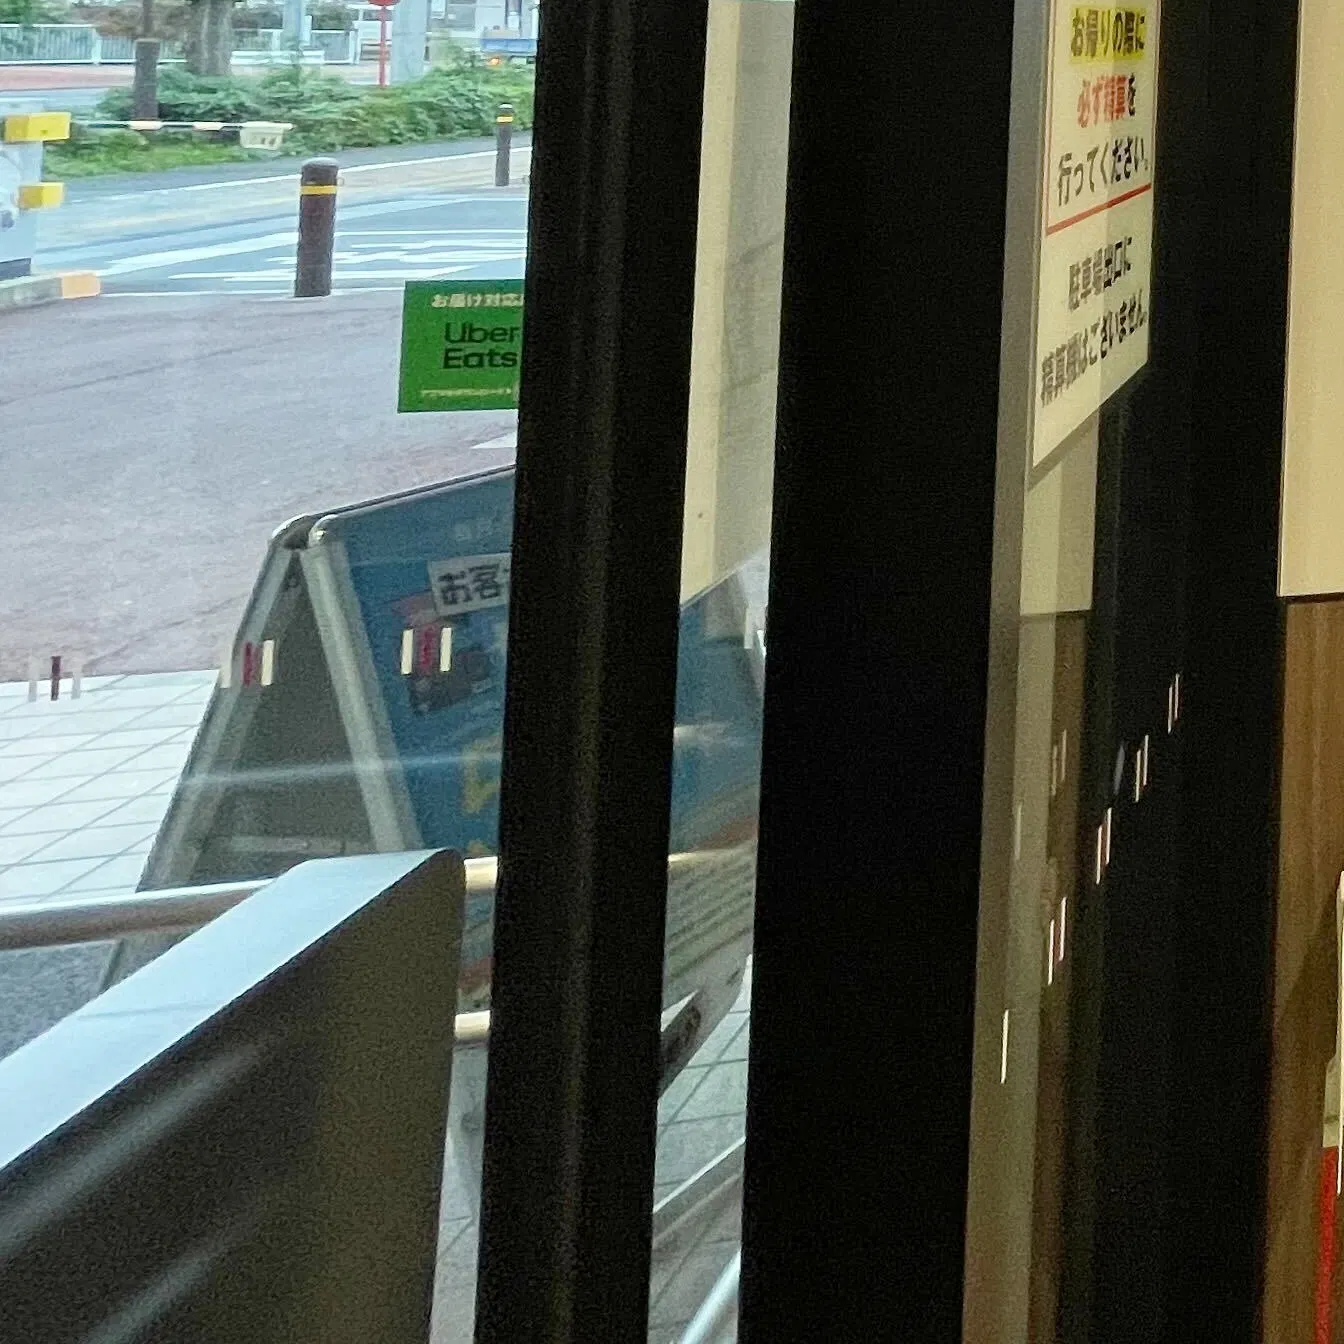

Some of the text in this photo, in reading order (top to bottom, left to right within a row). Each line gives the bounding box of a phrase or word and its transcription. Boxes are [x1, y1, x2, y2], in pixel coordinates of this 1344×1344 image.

[1071, 8, 1145, 58] お帰りの際に
[1076, 74, 1137, 129] 必ず精算を
[1057, 135, 1149, 208] 行ってください。
[1069, 236, 1133, 311] 駐車場出口に
[443, 347, 518, 369] Eats
[444, 322, 519, 344] Uber
[1040, 288, 1148, 408] 精算機はございません。
[438, 563, 509, 606] お客
